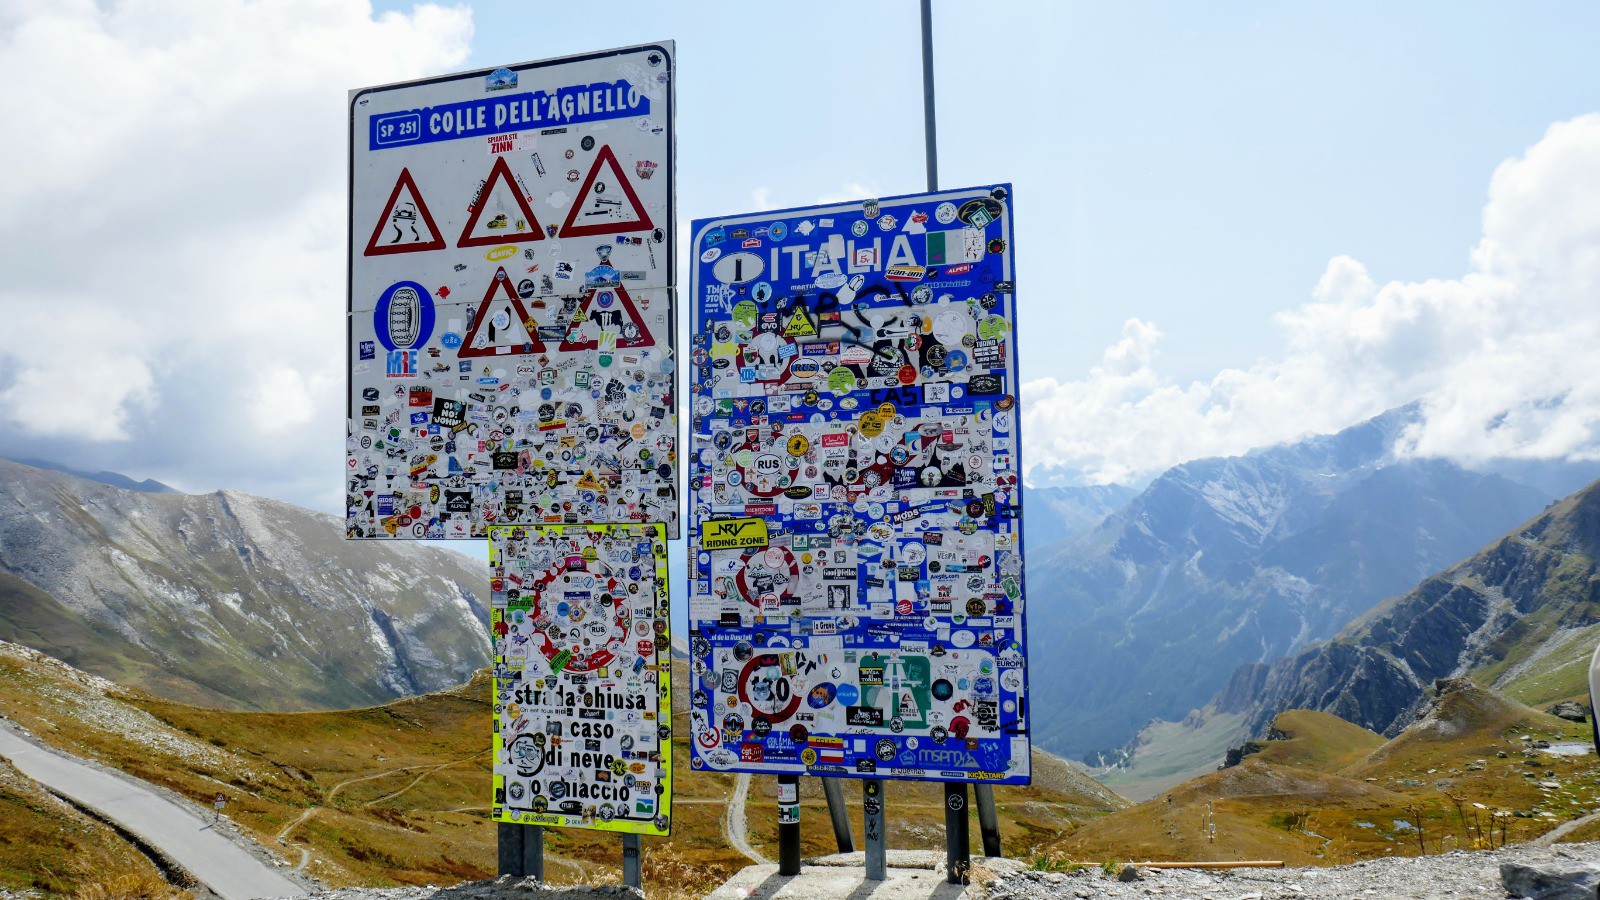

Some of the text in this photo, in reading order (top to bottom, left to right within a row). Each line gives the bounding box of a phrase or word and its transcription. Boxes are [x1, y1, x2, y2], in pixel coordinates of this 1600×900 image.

[380, 120, 417, 137] SP 251
[429, 105, 486, 135] COLLE
[770, 234, 920, 281] ITALIA
[734, 258, 743, 281] I
[887, 268, 923, 278] can-am
[795, 363, 816, 372] RUS
[757, 459, 780, 469] RUS
[706, 536, 765, 548] RIDING ZONE
[570, 721, 614, 739] caso
[546, 744, 616, 769] di neve
[531, 776, 630, 802] o hiaccio
